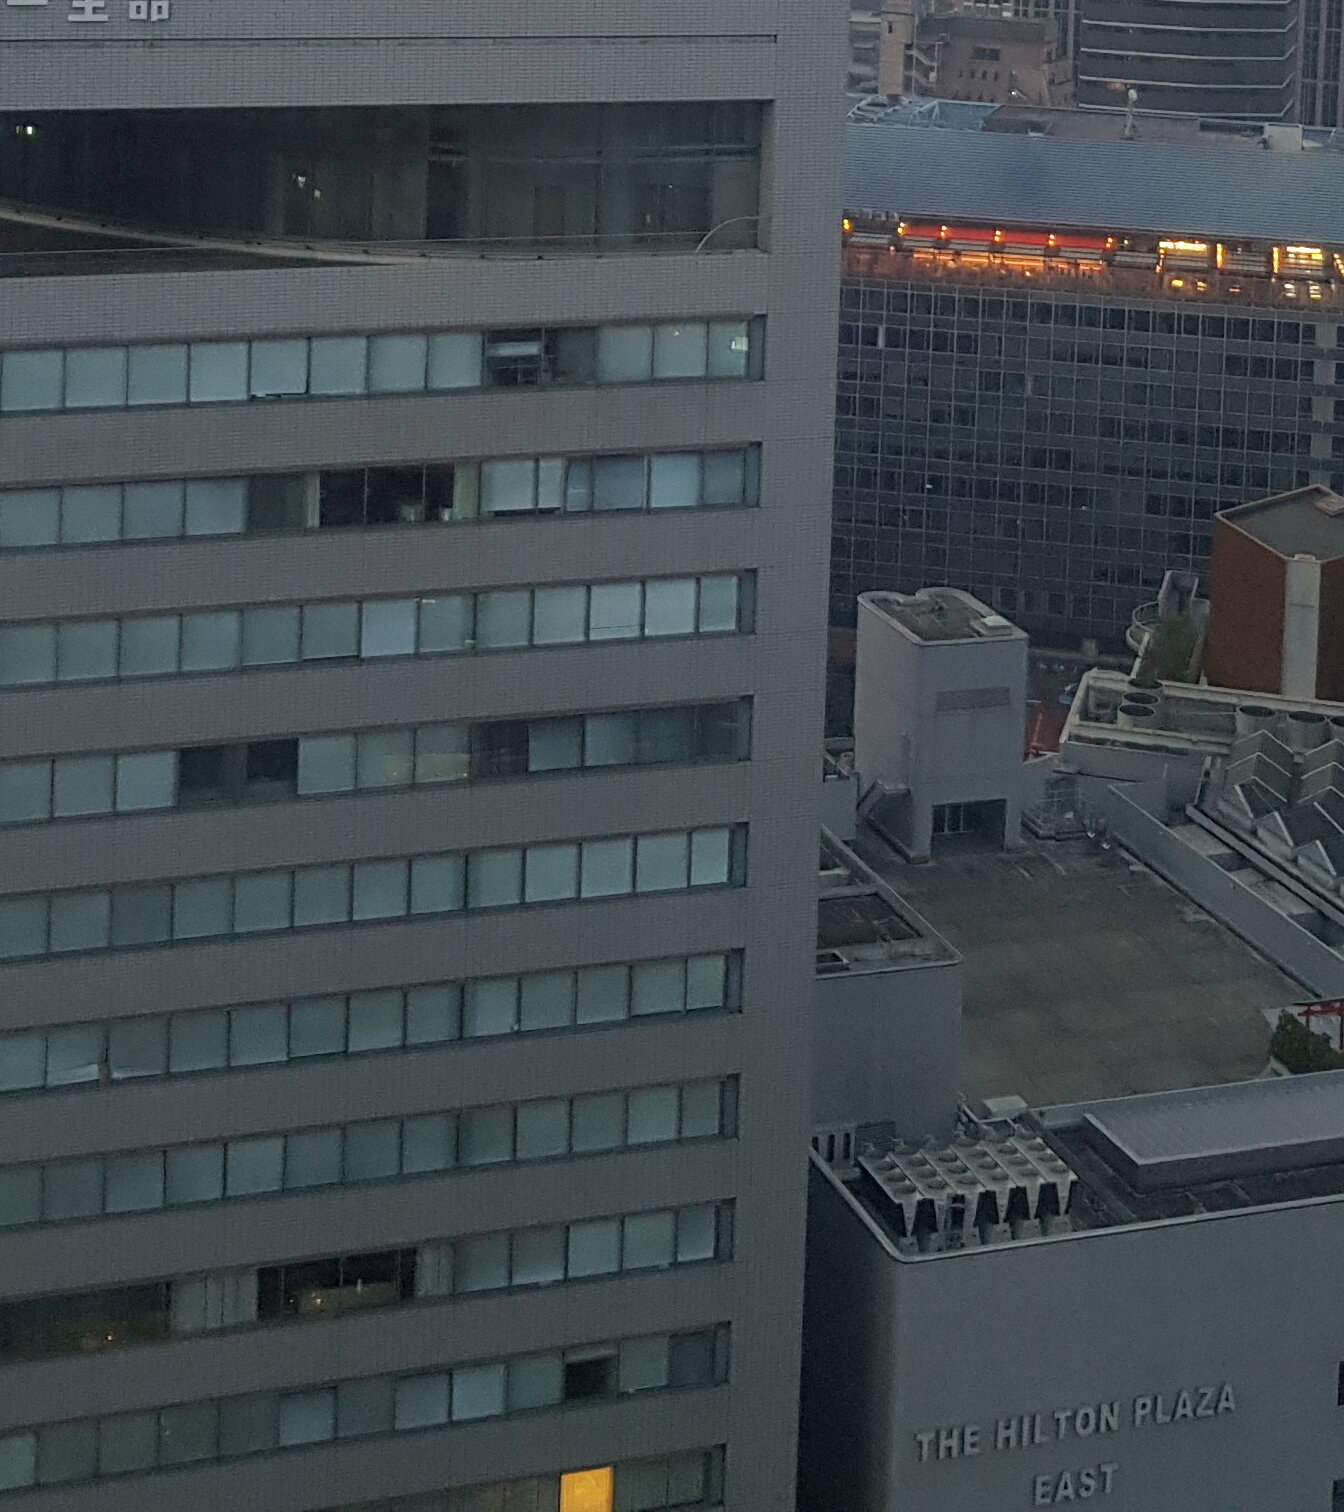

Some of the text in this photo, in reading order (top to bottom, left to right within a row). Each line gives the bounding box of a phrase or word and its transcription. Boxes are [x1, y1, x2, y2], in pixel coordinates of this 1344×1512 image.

[914, 1382, 1237, 1462] THE HILTON PLAZA
[1032, 1461, 1120, 1507] EAST
